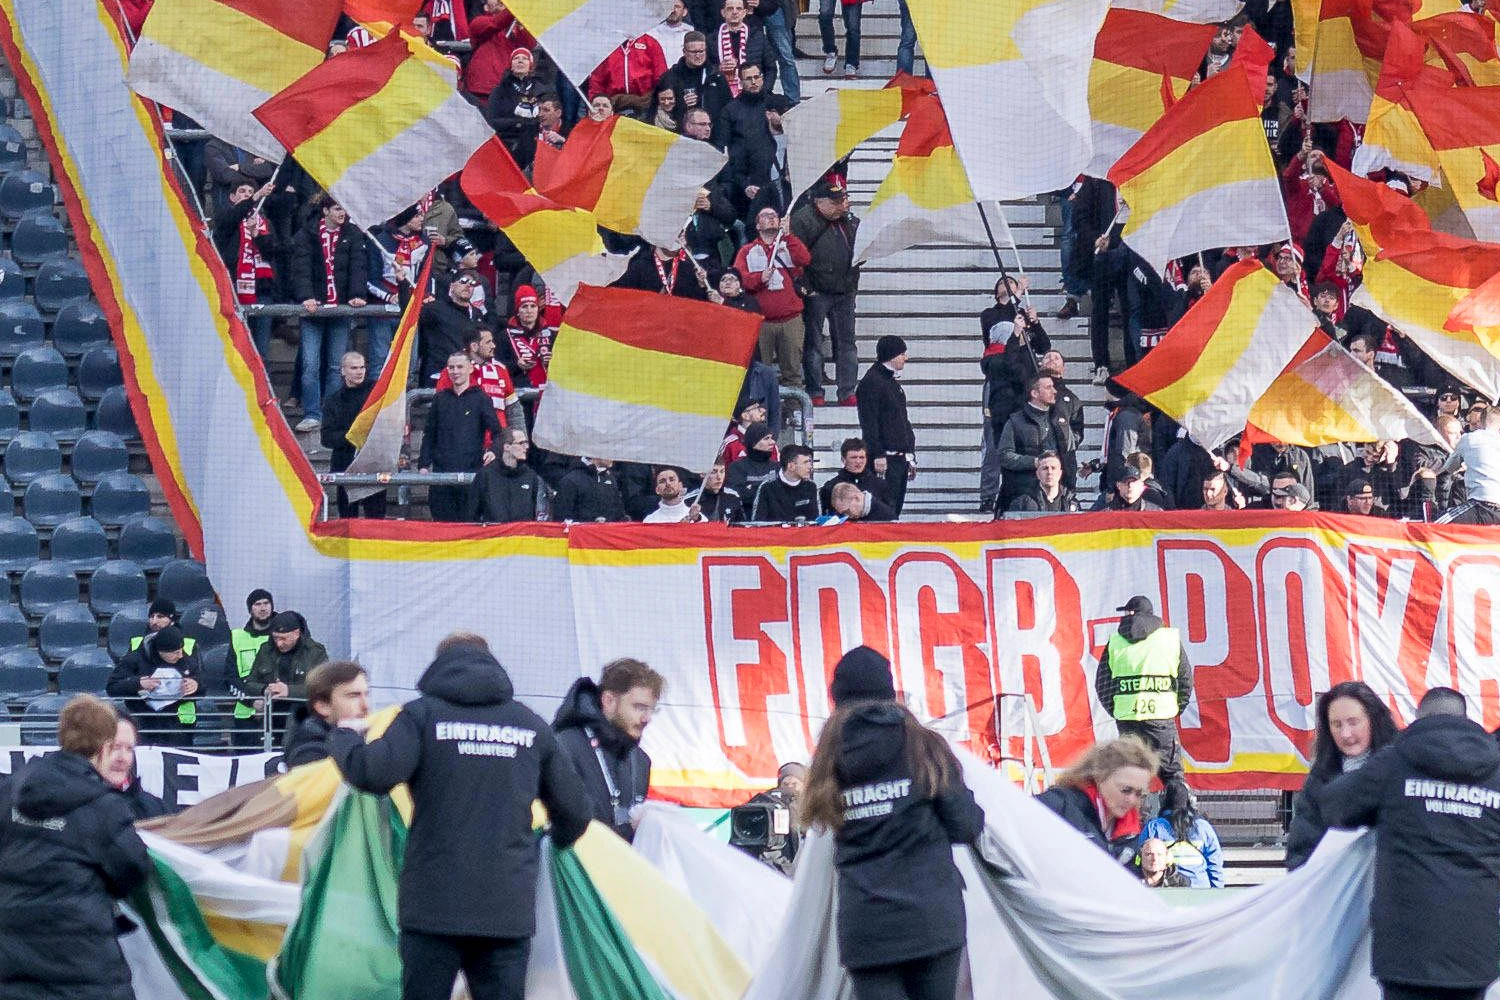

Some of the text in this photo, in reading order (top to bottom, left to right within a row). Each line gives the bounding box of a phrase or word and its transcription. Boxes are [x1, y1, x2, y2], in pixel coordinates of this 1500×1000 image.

[1120, 677, 1171, 692] STEWARD
[436, 722, 537, 748] EINTRACHT
[843, 779, 912, 806] TRACHT
[1425, 799, 1483, 818] VOLUNTEER
